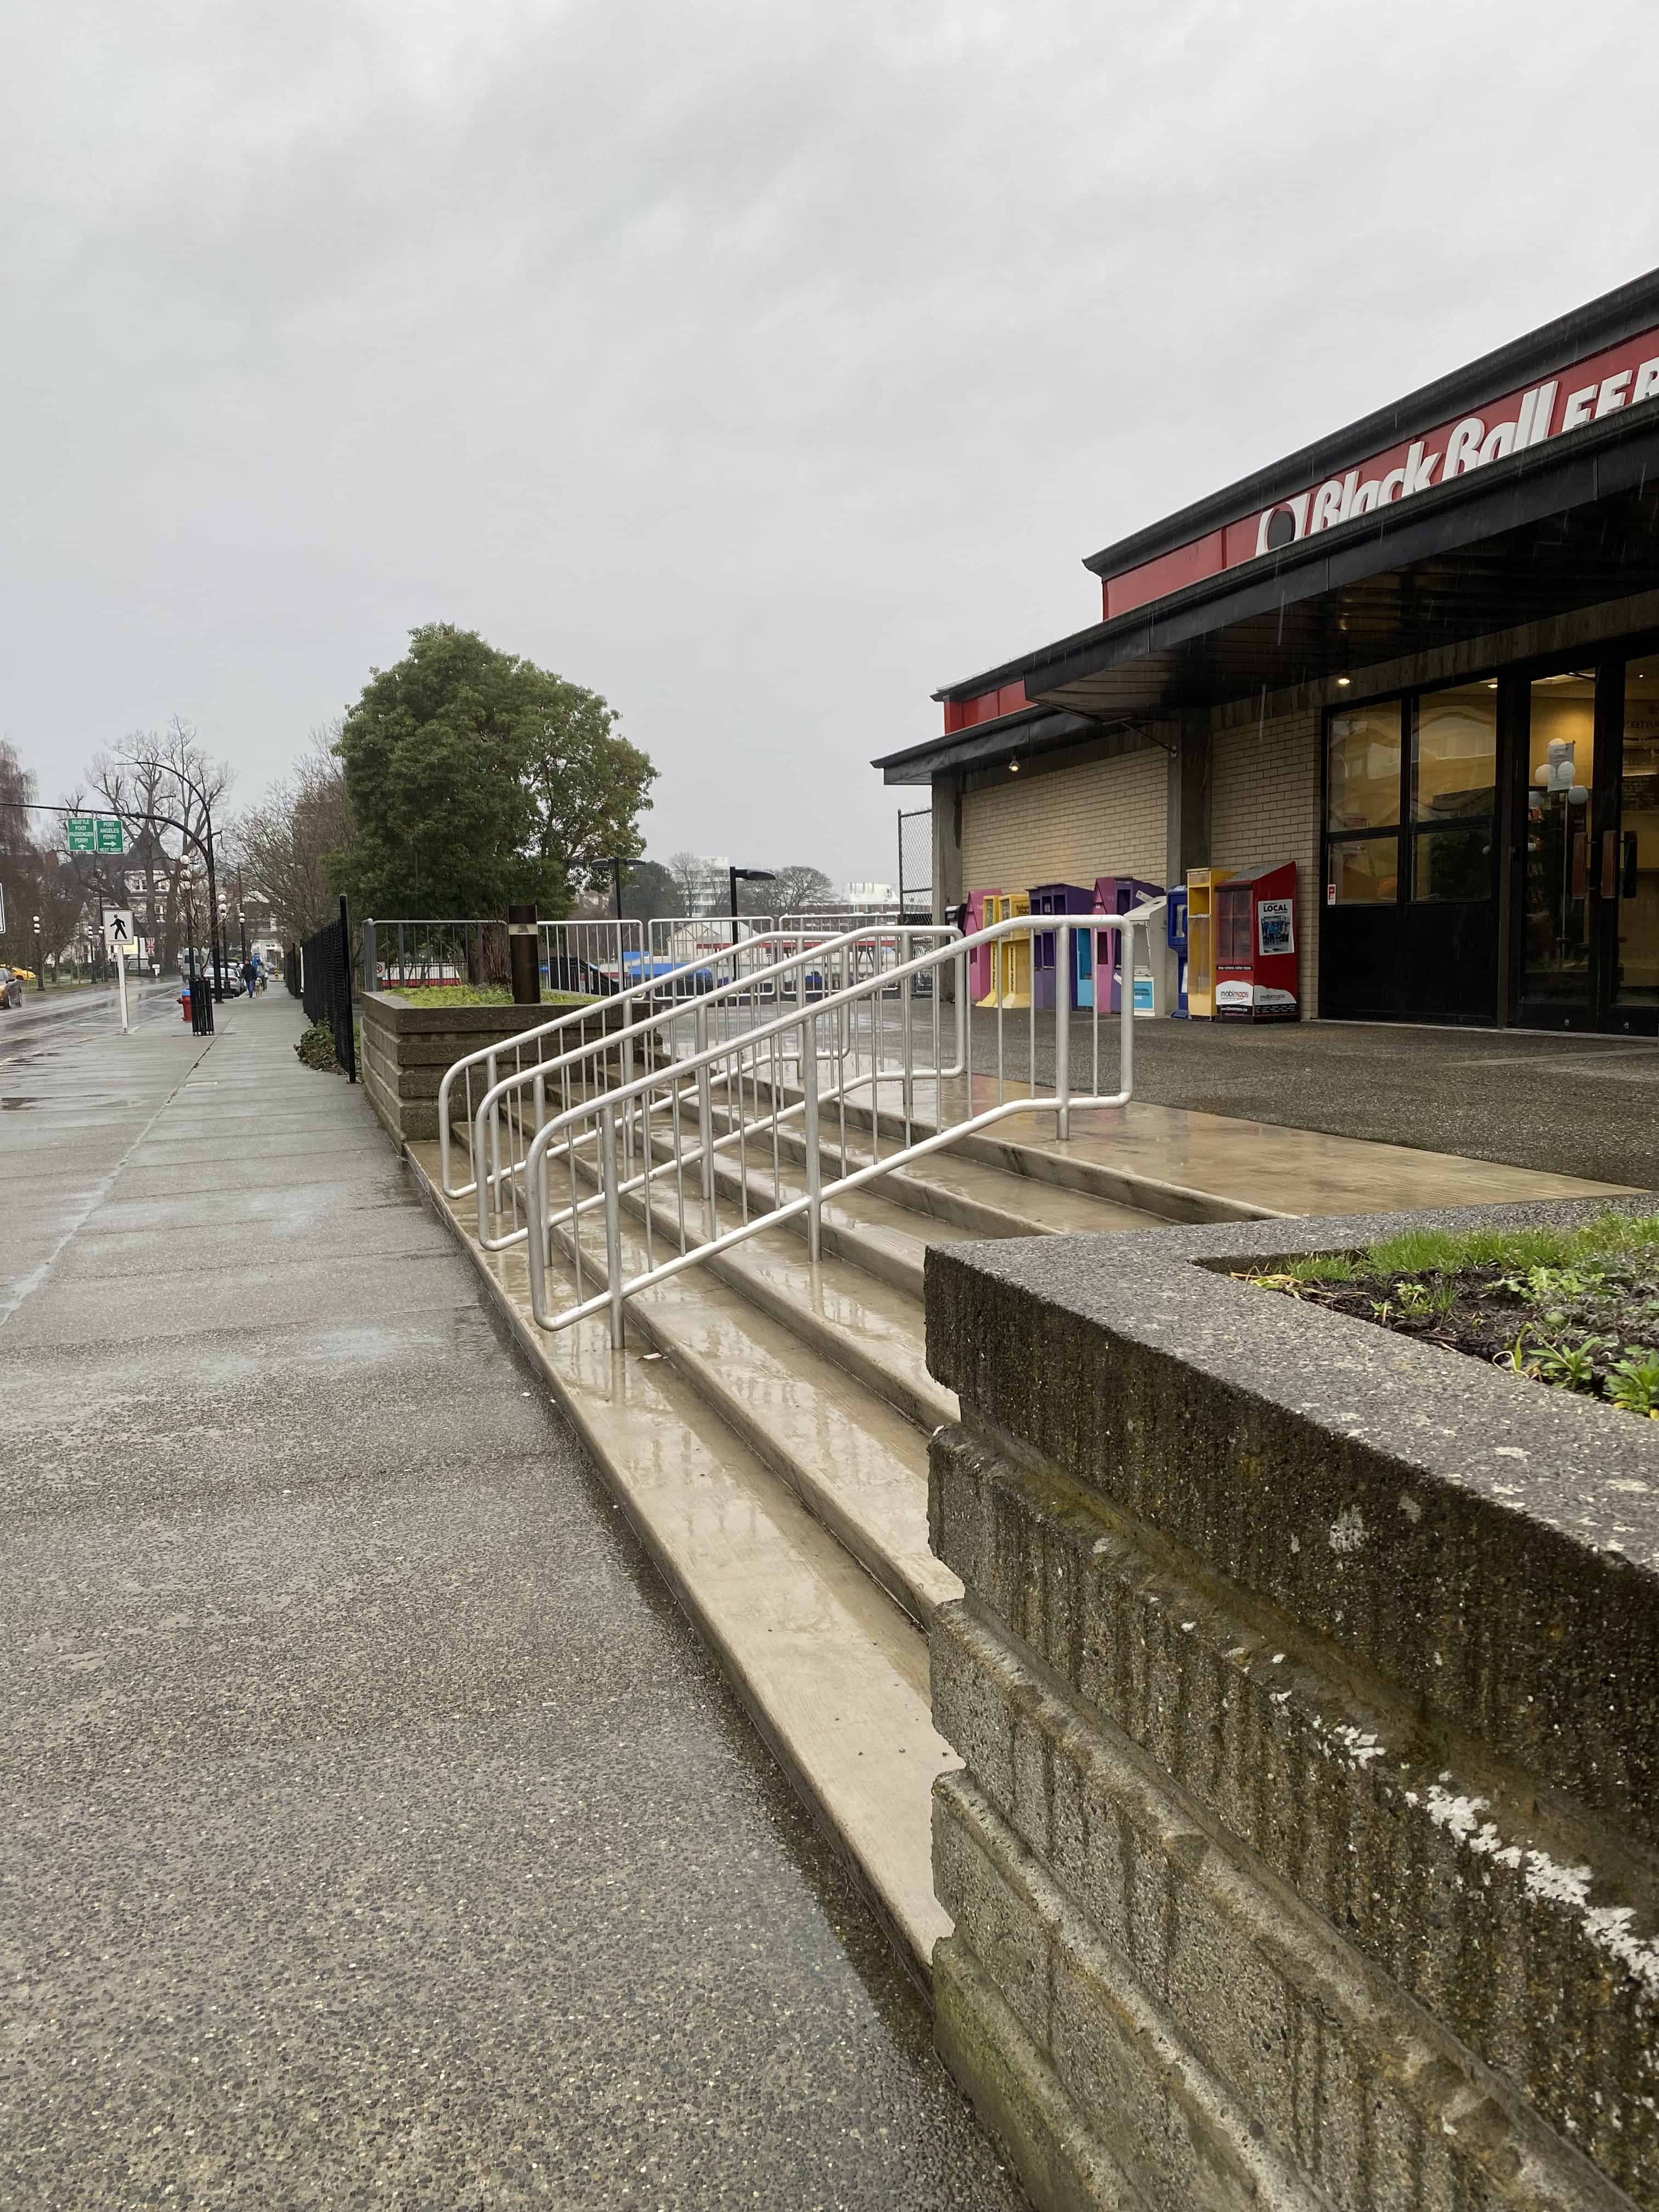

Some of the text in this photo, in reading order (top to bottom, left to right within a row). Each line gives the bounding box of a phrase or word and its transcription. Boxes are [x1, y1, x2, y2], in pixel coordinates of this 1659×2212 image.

[1310, 441, 1442, 535] Black
[1442, 380, 1559, 481] Ball
[1263, 904, 1288, 912] LOCAL
[1221, 990, 1249, 998] mobimaps
